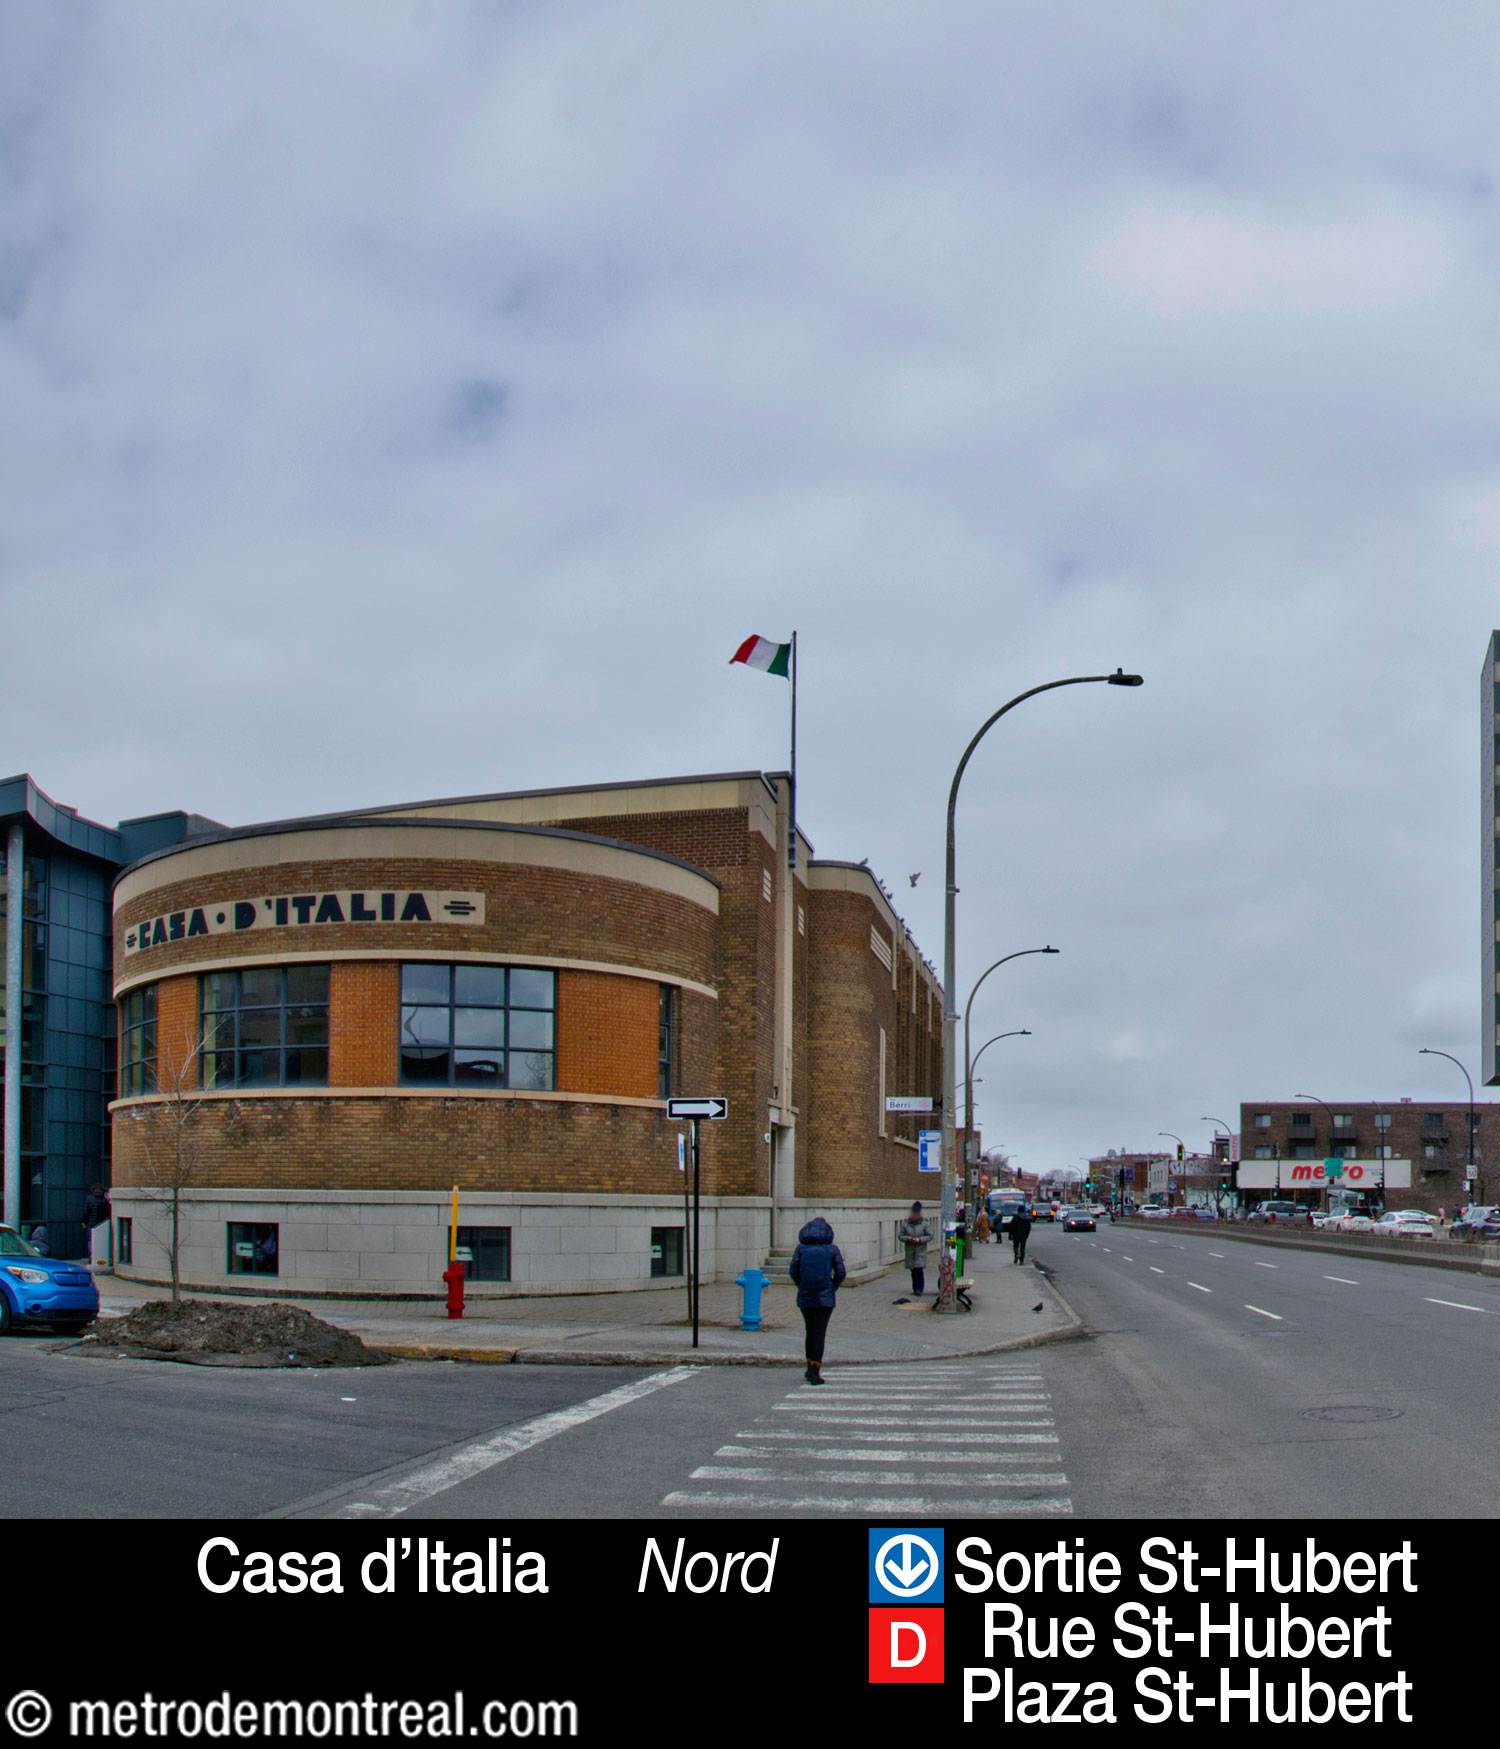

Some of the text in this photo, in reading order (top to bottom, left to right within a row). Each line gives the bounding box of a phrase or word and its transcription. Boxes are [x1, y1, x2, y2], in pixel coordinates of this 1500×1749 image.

[138, 892, 432, 949] CASA D'ITALIA
[889, 1101, 911, 1109] Berri
[1291, 1165, 1364, 1180] mero
